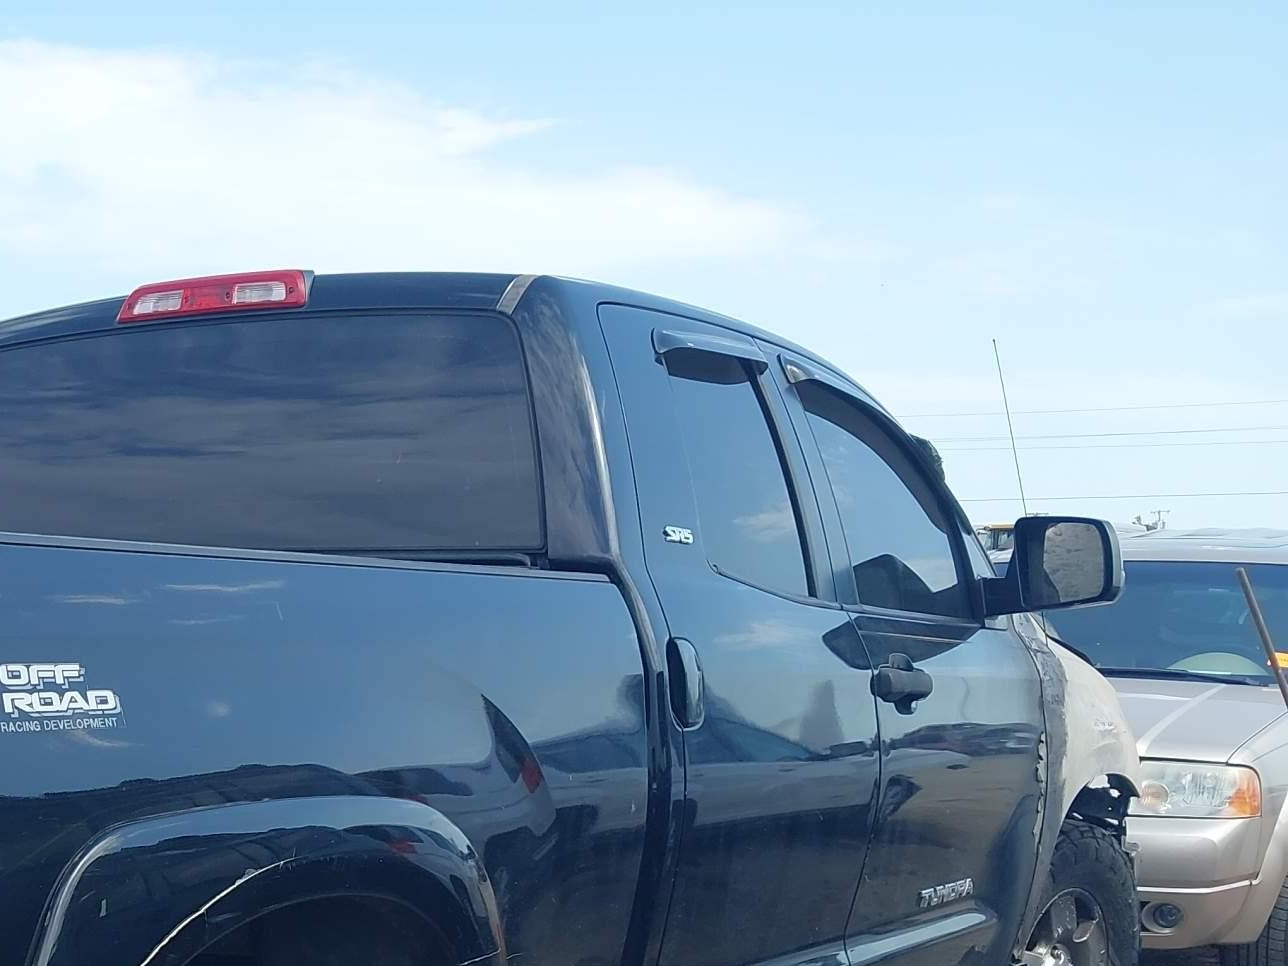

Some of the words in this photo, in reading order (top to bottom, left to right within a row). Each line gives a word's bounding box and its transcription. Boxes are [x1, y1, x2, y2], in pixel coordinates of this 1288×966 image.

[2, 689, 121, 718] ROAD
[0, 720, 42, 733] RACING
[44, 717, 118, 732] DEVELOPMENT
